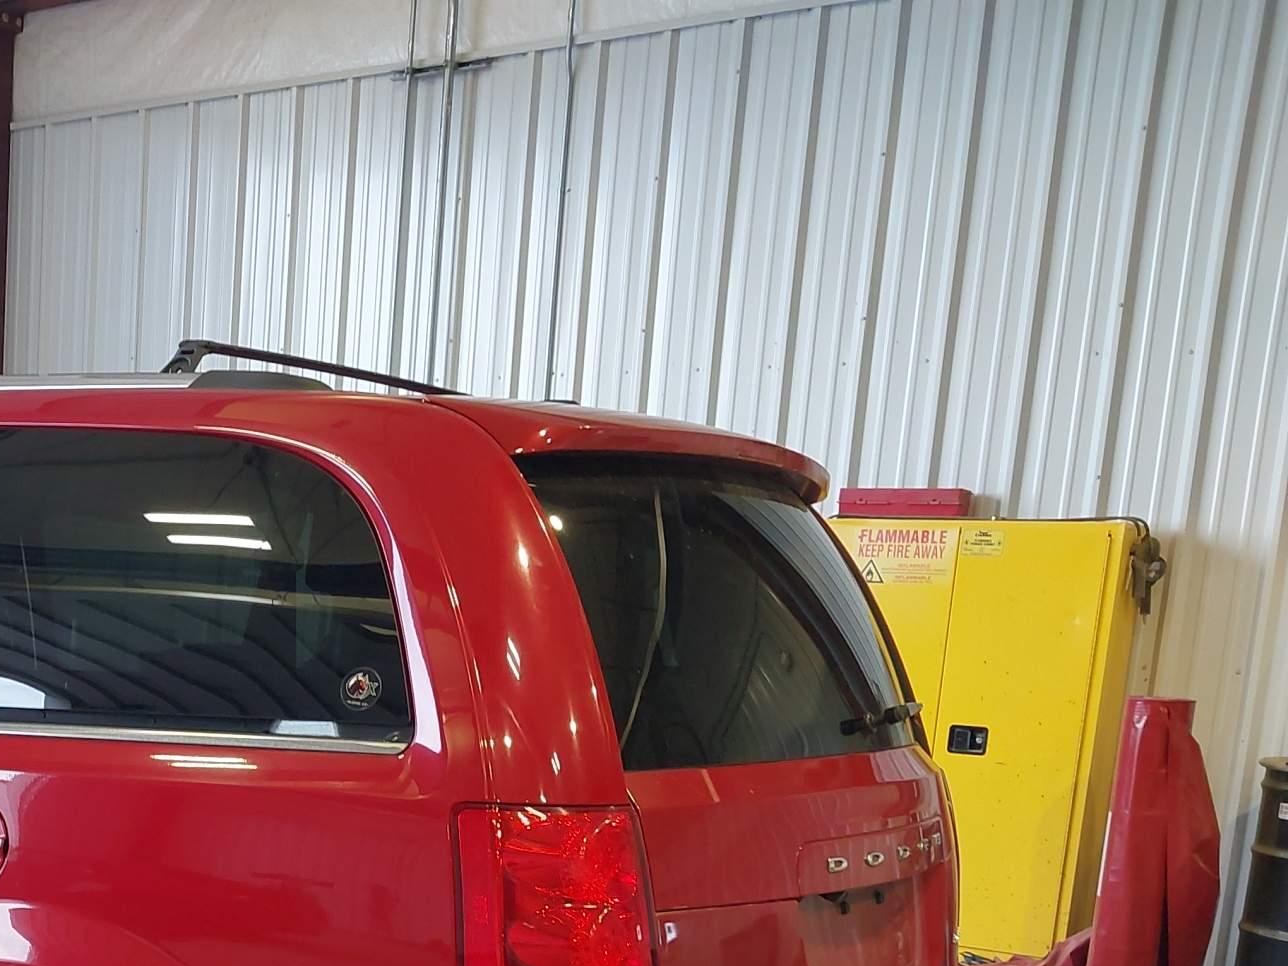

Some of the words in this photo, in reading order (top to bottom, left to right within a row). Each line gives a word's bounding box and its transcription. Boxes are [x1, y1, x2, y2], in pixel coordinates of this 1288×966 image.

[858, 528, 948, 545] FLAMMABLE
[858, 543, 884, 558] KEEP
[886, 544, 911, 559] FIRE
[913, 545, 946, 560] AWAY
[827, 832, 942, 872] DOD
